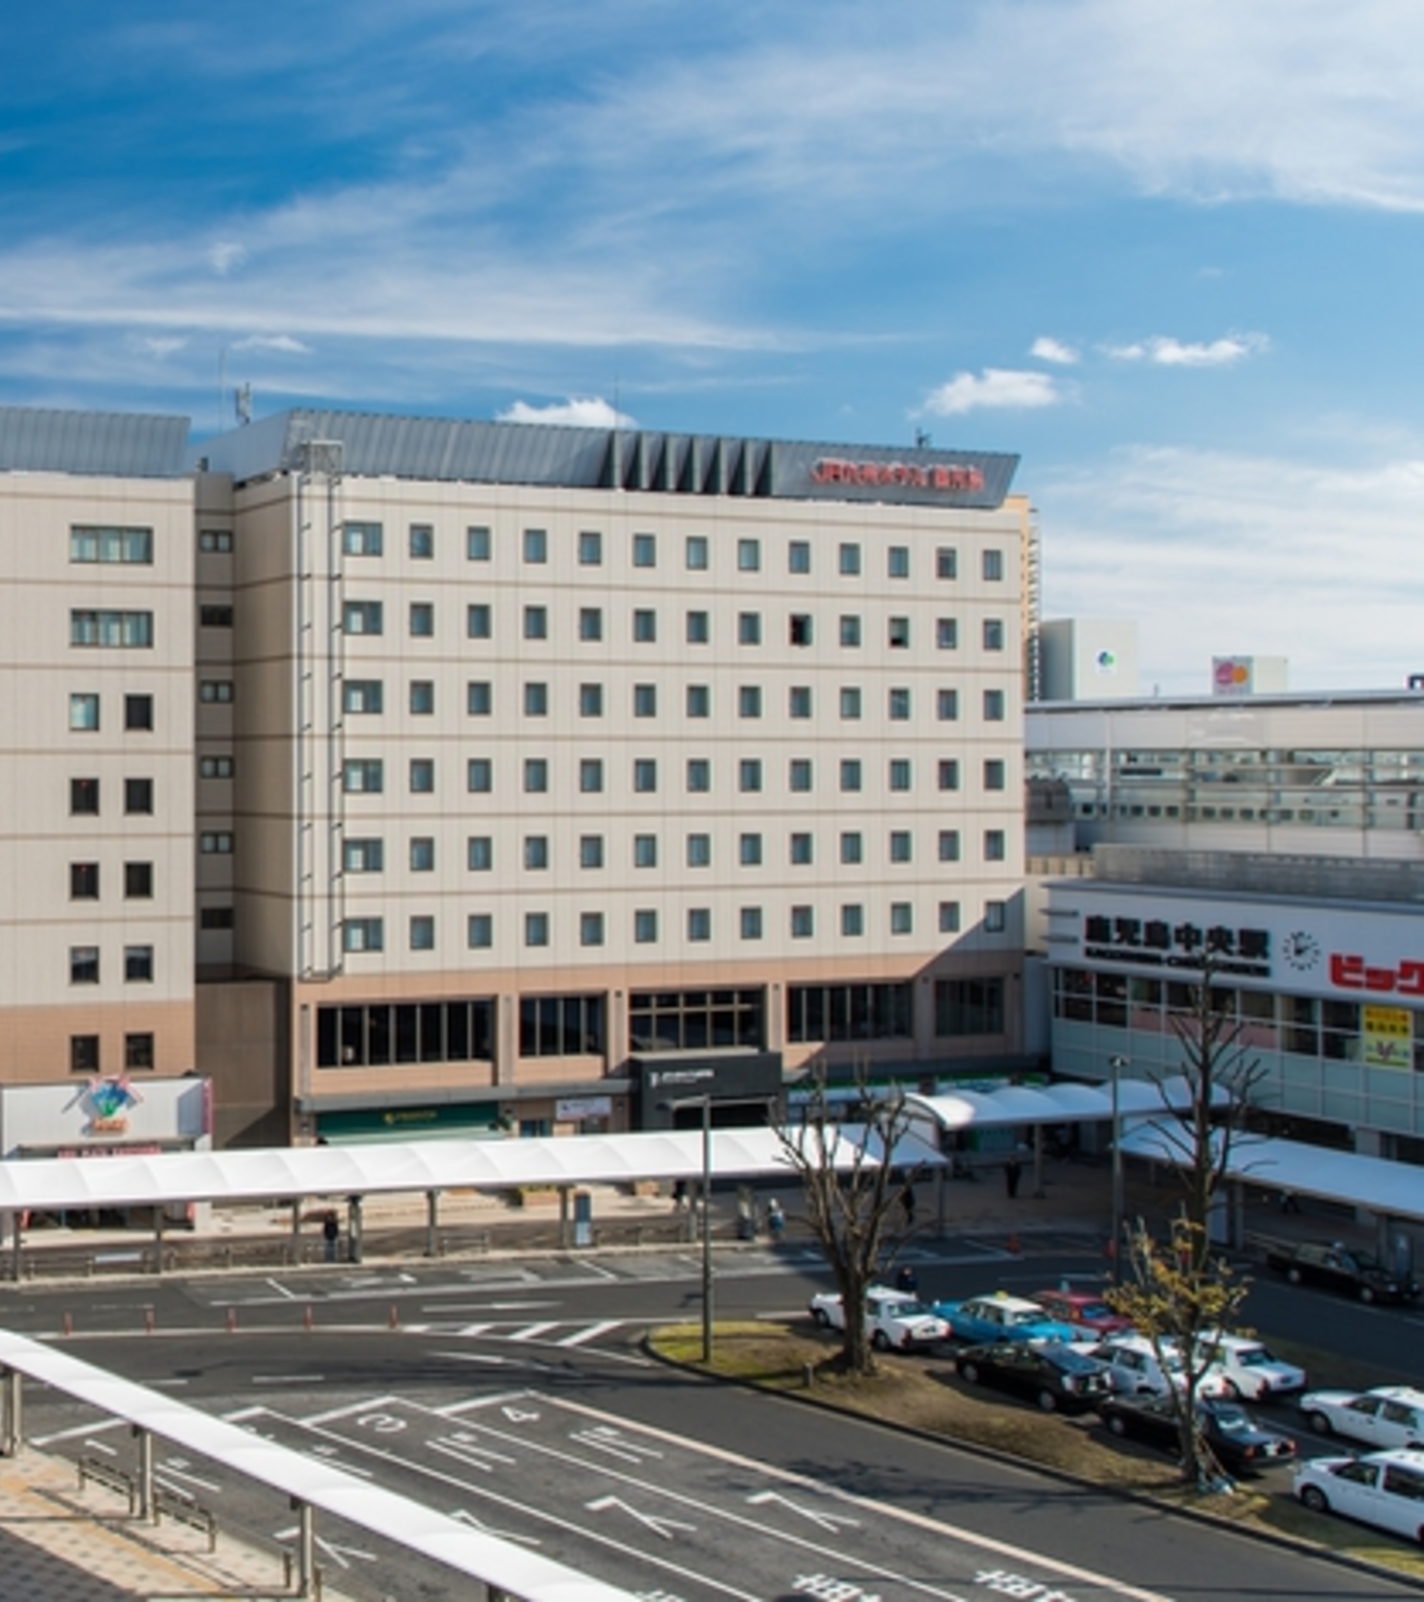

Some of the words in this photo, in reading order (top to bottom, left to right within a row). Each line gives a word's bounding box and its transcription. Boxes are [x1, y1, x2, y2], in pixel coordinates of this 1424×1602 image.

[1085, 914, 1270, 959] 鹿児島中央駅
